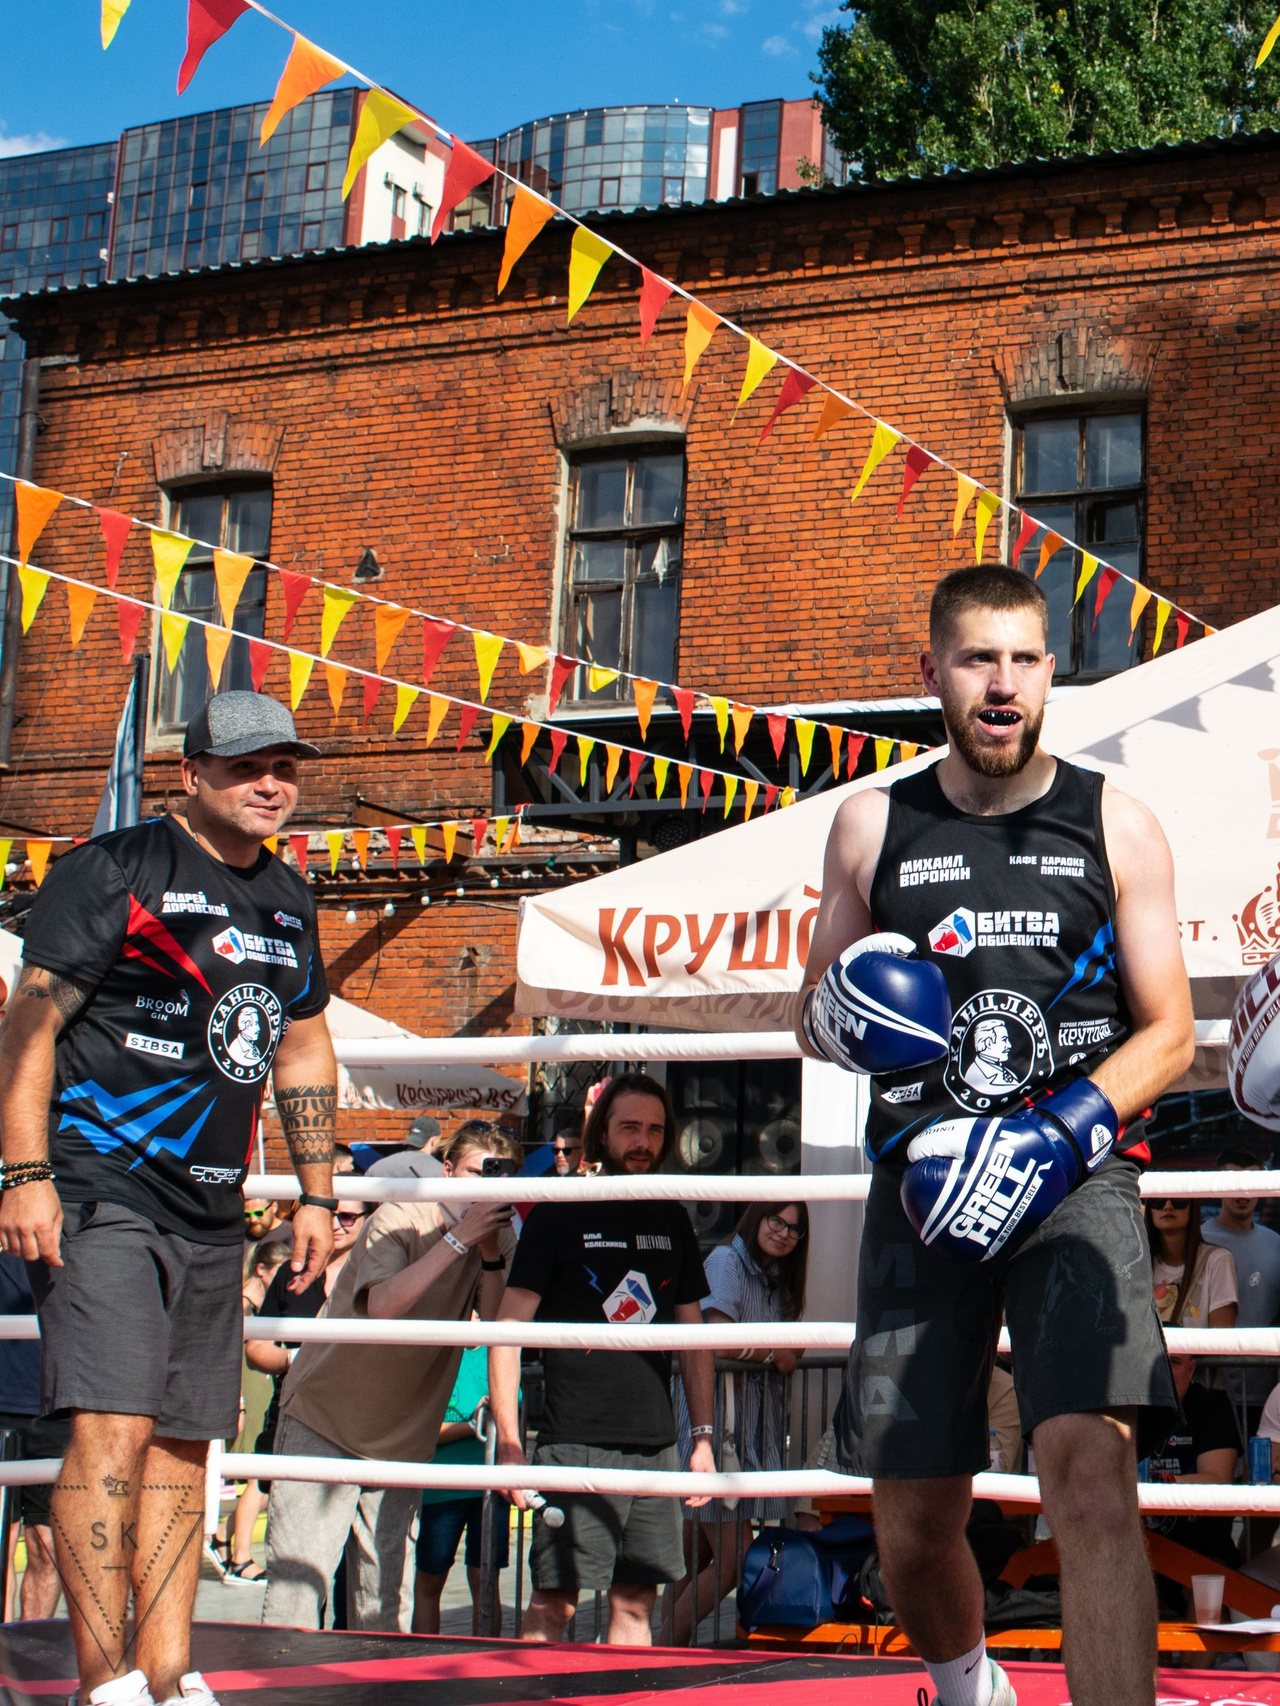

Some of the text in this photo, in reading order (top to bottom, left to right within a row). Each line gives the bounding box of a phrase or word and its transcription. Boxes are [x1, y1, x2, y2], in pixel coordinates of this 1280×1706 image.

[900, 854, 964, 875] МИХАИЛ
[1009, 855, 1085, 868] КАФЕ КАРАОКЕ
[1040, 867, 1085, 877] ПЯТНИЦА
[900, 867, 971, 888] ВОРОНИН
[162, 891, 207, 904] АНДРЕЙ
[162, 902, 230, 917] ДОРОВСКОЙ
[977, 911, 1060, 934] БИТВА
[243, 933, 297, 958] БИТВА
[977, 934, 1058, 948] ОБЩЕПИТОВ
[246, 950, 299, 968] ОБЩЕПИТОВ
[151, 1012, 168, 1021] GIN
[212, 987, 280, 1042] КАНЦЛЕРЪ
[816, 975, 868, 1041] REEN
[951, 994, 1045, 1063] КАНЦЛЕРЪ
[131, 1037, 179, 1055] SIBSA
[221, 1057, 266, 1078] 2010
[949, 1129, 1021, 1238] GREEN
[966, 1157, 1036, 1246] HILL
[997, 1184, 1038, 1243] BE YOUR BEST SELF
[584, 1241, 627, 1249] КОЛЕСНИКОВ
